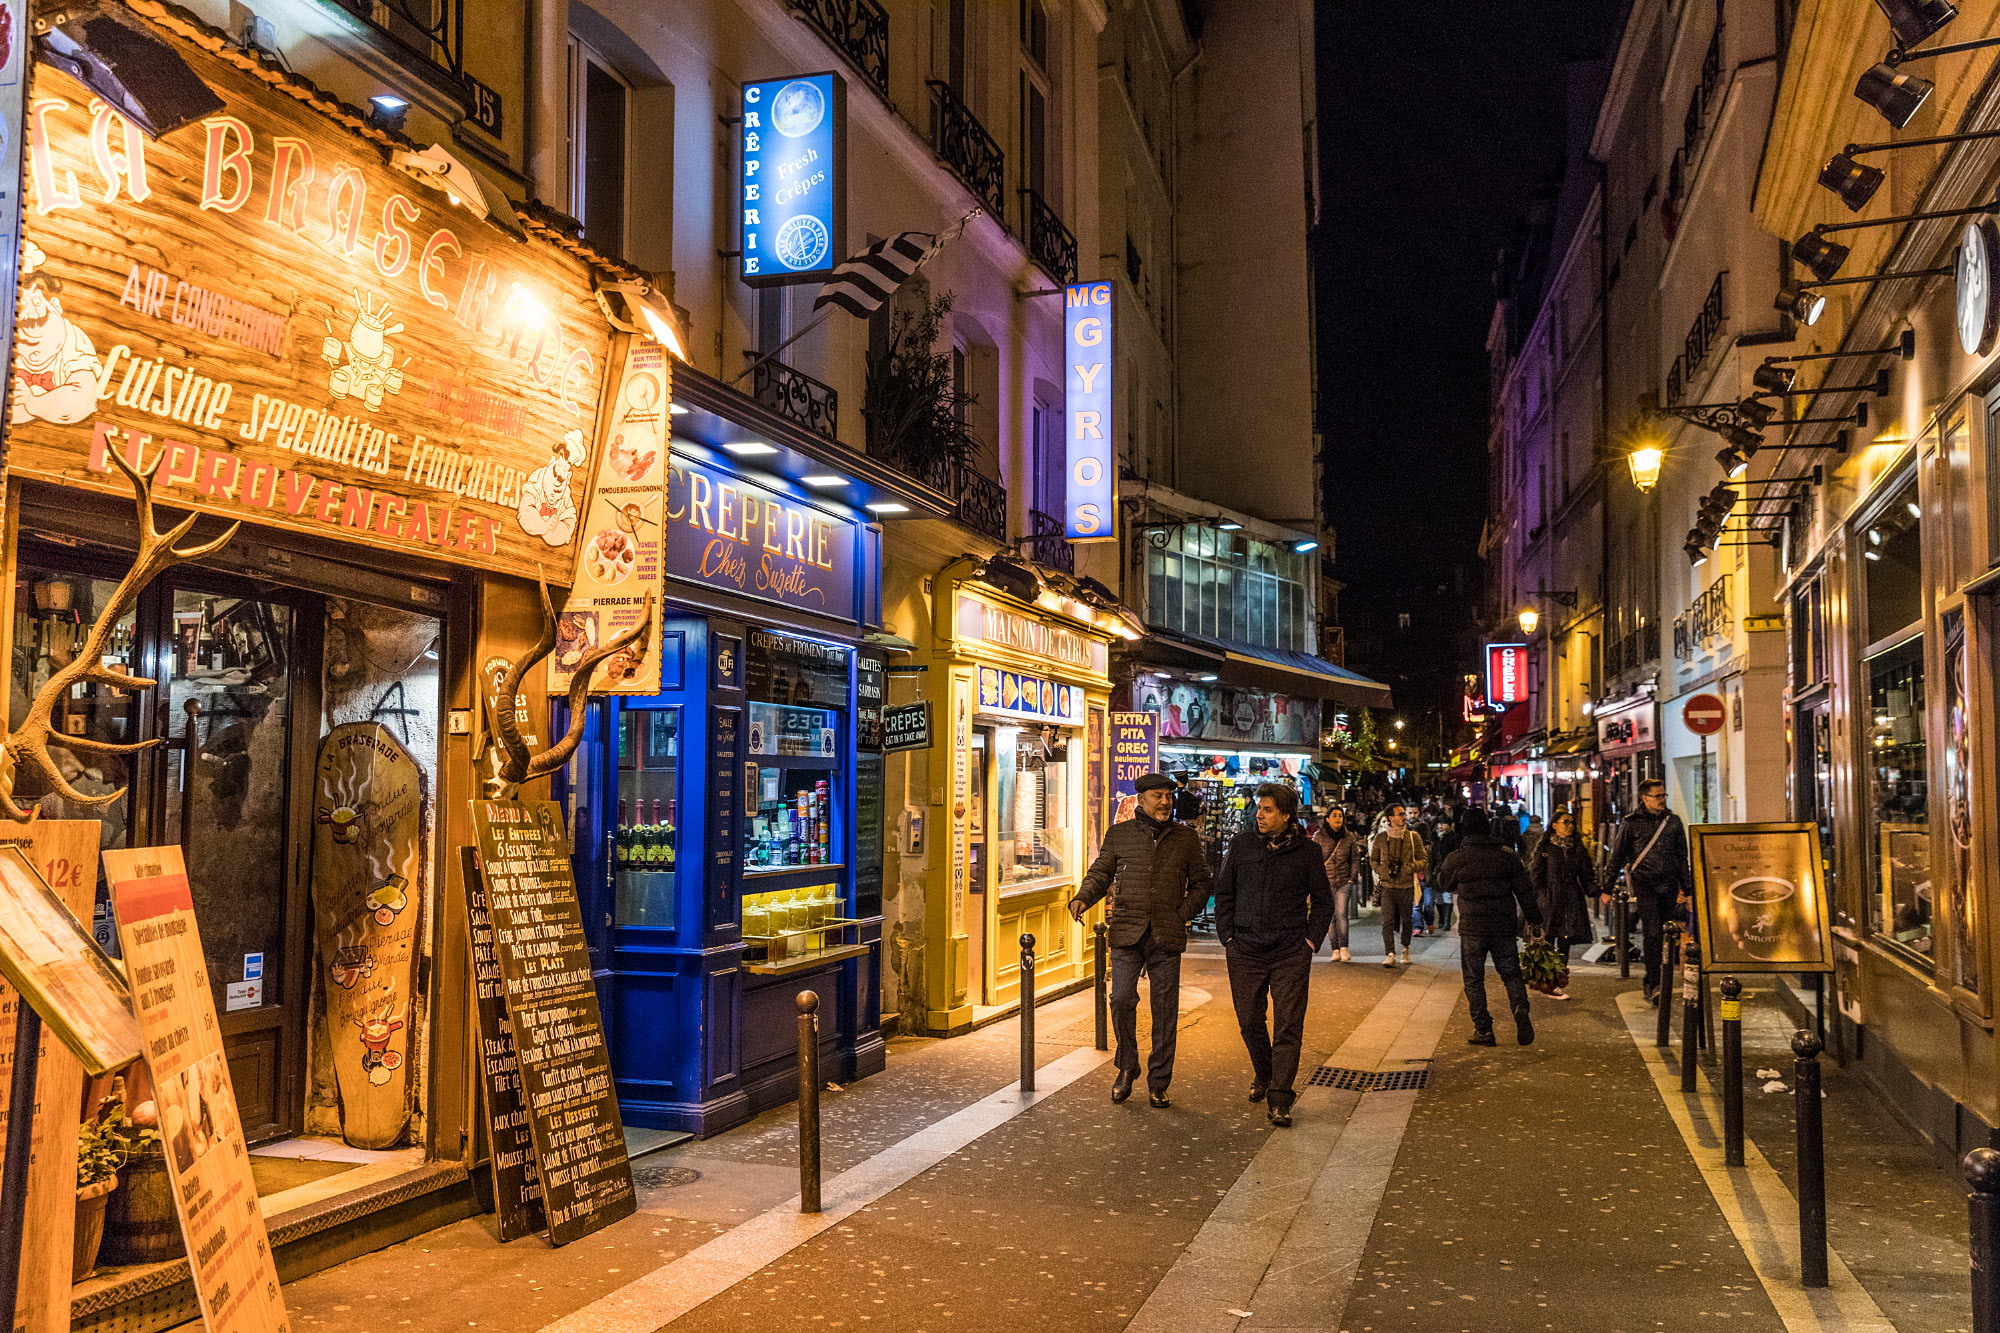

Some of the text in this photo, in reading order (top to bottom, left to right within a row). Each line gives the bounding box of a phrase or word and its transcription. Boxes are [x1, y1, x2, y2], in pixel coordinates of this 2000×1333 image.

[473, 83, 494, 127] 15
[31, 97, 152, 216] LA
[776, 148, 818, 180] Fresh
[745, 87, 760, 274] CRÊPERIE
[775, 169, 825, 205] Crêpes
[120, 265, 168, 318] AIR
[1066, 285, 1111, 308] MG
[97, 345, 233, 430] Cuisine
[1073, 316, 1104, 535] GYROS
[88, 421, 152, 475] ET
[697, 539, 825, 606] Chez Suzette
[593, 597, 632, 606] PIERRADE
[751, 631, 784, 652] CRÊPES
[792, 639, 824, 659] FROMENT
[983, 606, 1093, 667] MAISON DE GYROS
[857, 656, 882, 673] GALETTES
[858, 683, 881, 699] SARRASIN
[719, 716, 733, 729] SALLE
[885, 710, 926, 733] CRÊPES
[1114, 713, 1152, 726] EXTRA
[885, 730, 926, 746] EAT IN TAKE AWAY
[1120, 728, 1146, 740] PITA
[338, 733, 400, 763] BRASERADE
[1114, 754, 1151, 764] seulement
[1116, 741, 1149, 754] GREC
[324, 753, 335, 771] LA
[1116, 764, 1150, 781] 5.00€
[486, 803, 521, 823] MENU
[497, 841, 504, 858] 6
[46, 857, 84, 888] 12€
[540, 957, 565, 971] PLATS
[564, 1104, 599, 1126] DESSERTS
